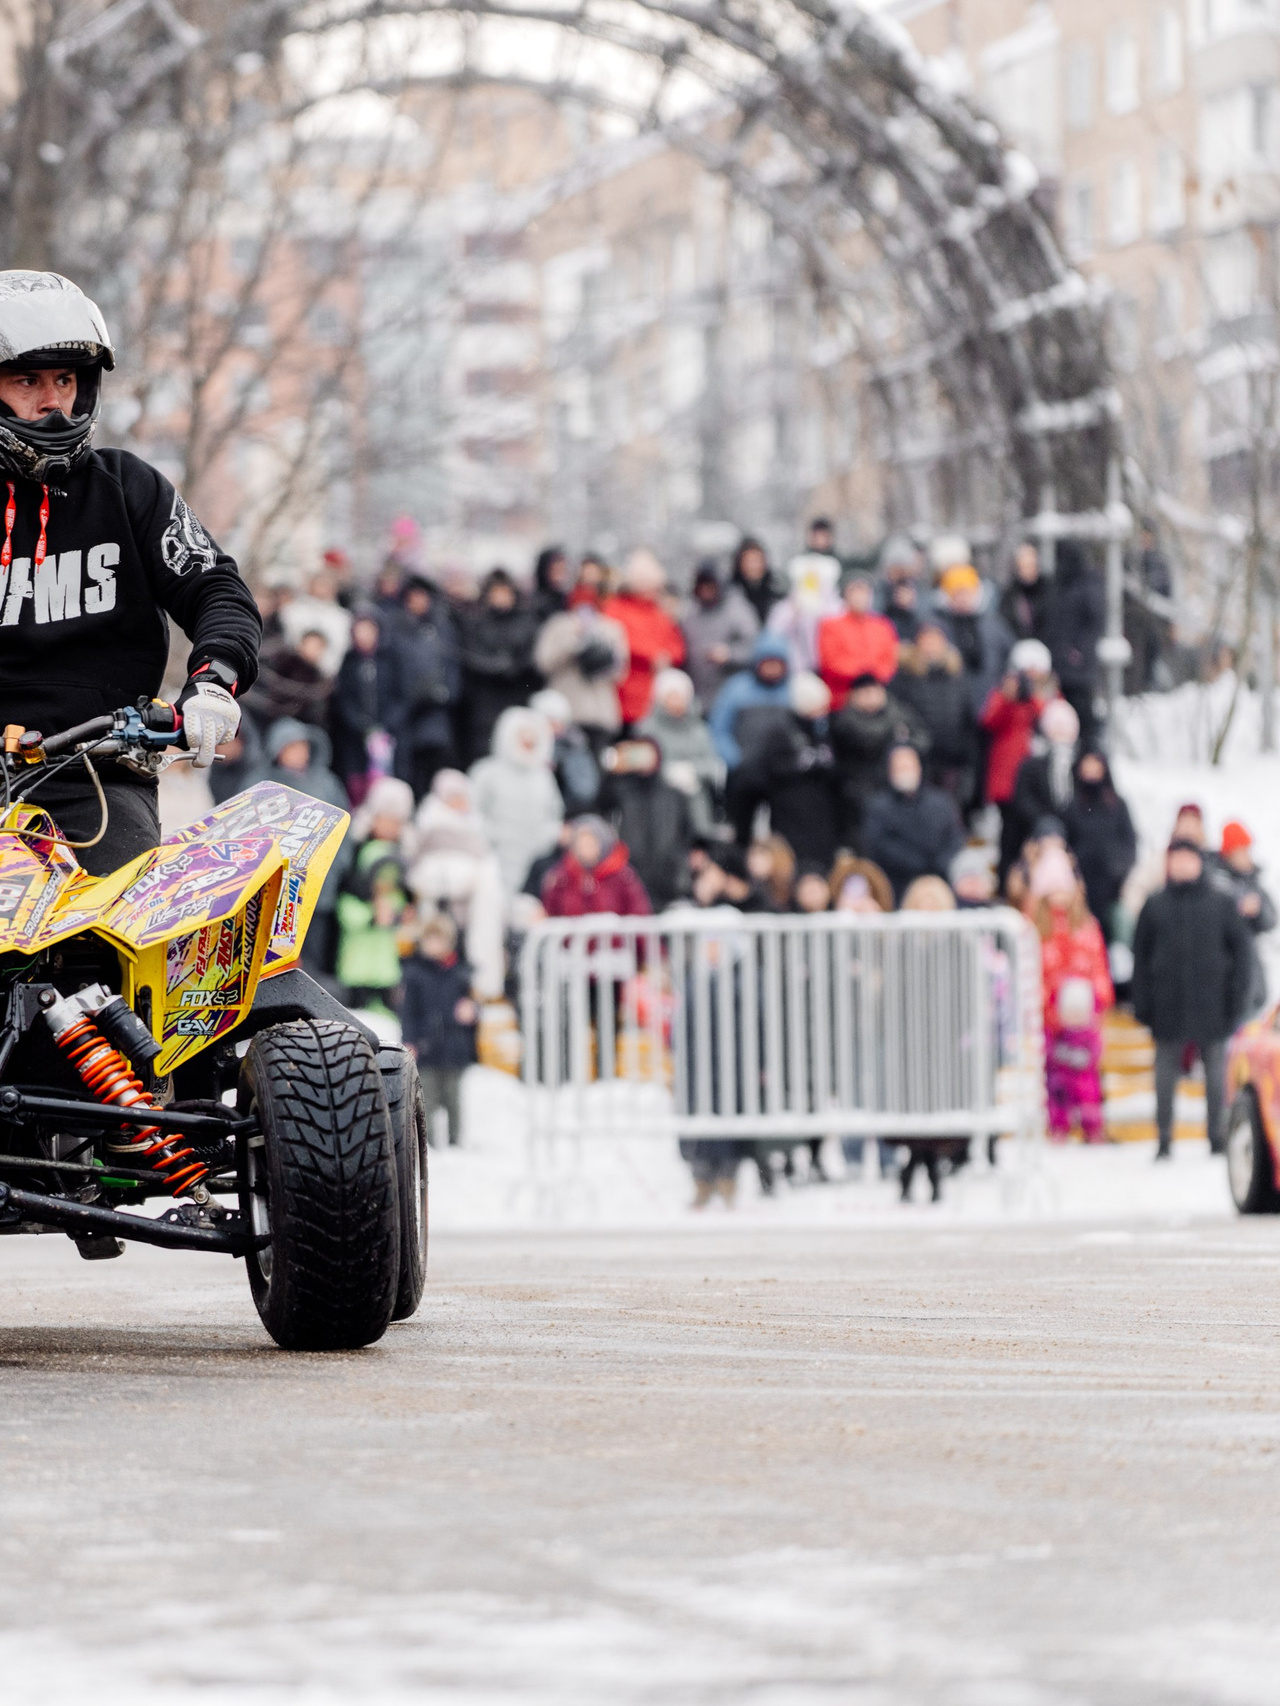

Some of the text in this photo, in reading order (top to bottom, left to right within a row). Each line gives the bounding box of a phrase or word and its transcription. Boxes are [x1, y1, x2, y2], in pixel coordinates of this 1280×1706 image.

[210, 843, 241, 861] VP
[121, 864, 170, 904] FOX
[216, 916, 235, 974] AMSO
[180, 990, 217, 1007] FOX
[177, 1019, 215, 1031] GAV
